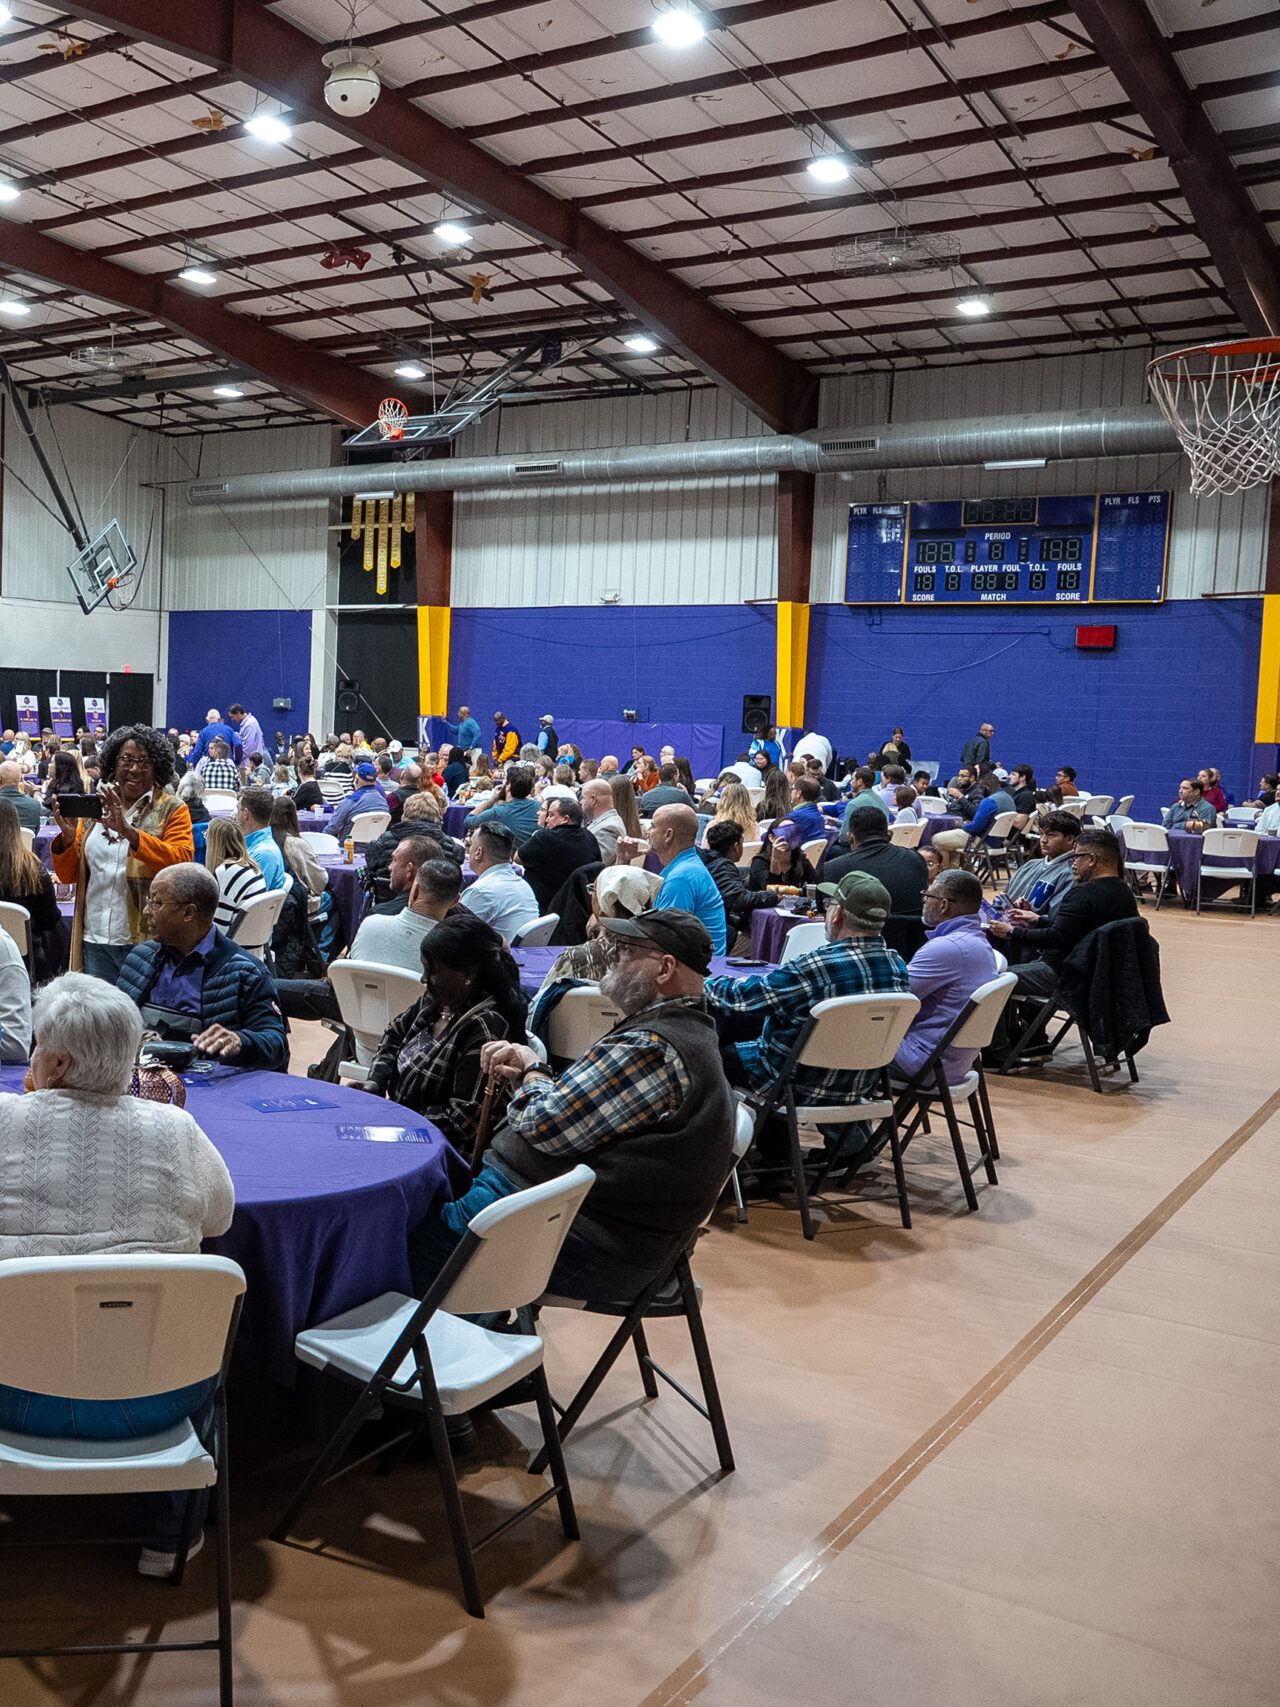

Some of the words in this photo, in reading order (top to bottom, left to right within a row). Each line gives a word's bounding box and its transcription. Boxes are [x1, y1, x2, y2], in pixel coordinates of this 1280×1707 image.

[1105, 497, 1121, 505] PLYR
[1128, 496, 1140, 504] FLS
[1148, 495, 1161, 503] PTS
[392, 496, 402, 562] SPONSIBILITY
[984, 532, 1011, 540] PERIOD
[378, 531, 387, 590] LEADERSHIP
[914, 565, 936, 573] FOULS
[945, 565, 964, 573] T.O.L.
[970, 564, 998, 572] PLAYER
[1002, 563, 1021, 572] FOUL
[1029, 563, 1049, 571] T.O.L.
[1057, 563, 1082, 571] FOULS
[980, 593, 1007, 601] MATCH
[1055, 592, 1081, 600] SCORE
